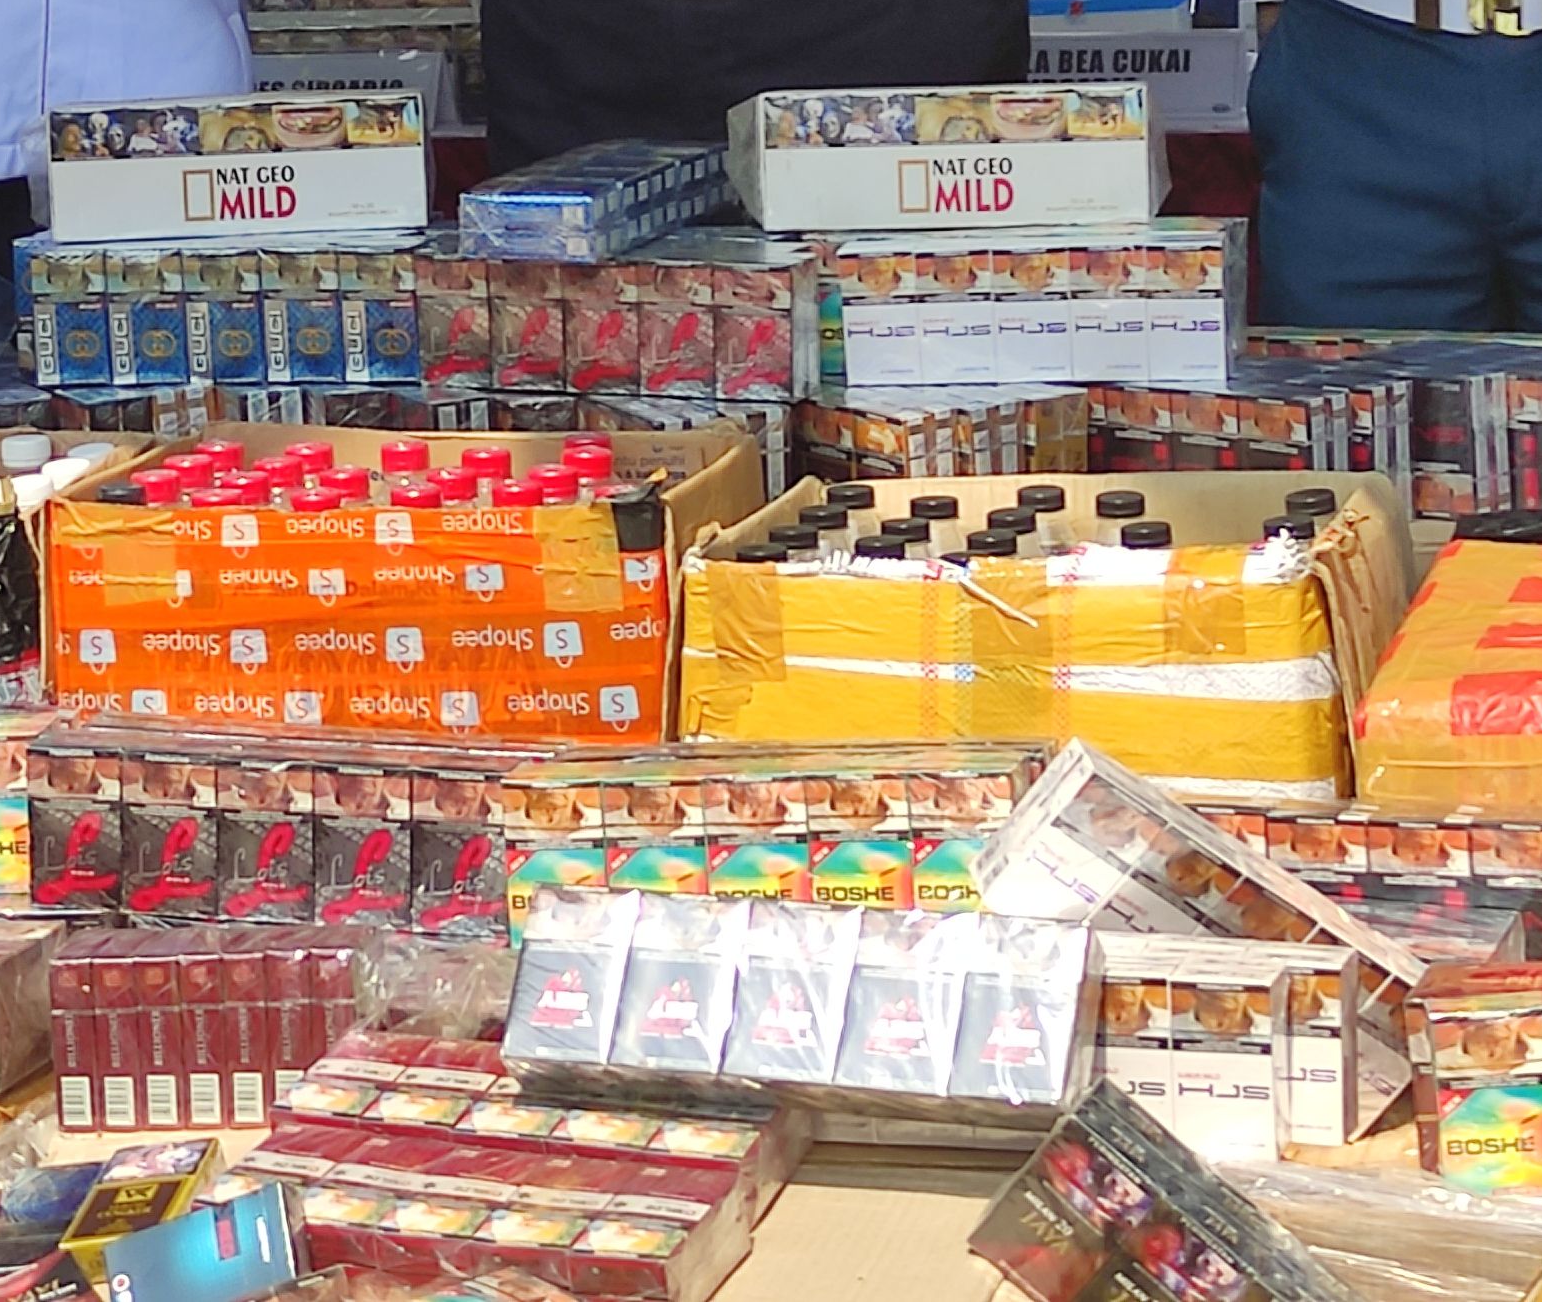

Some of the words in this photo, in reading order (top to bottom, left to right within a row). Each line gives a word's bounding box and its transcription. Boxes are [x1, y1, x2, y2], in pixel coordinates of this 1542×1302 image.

[1058, 49, 1105, 73] BEA
[1112, 49, 1191, 73] CUKAI
[215, 167, 252, 187] NAT
[257, 164, 295, 184] GEO
[932, 157, 968, 177] NAT
[973, 156, 1013, 176] GEO
[219, 185, 297, 221] MILD
[934, 177, 1015, 213] MILD
[440, 505, 524, 535] Shopee
[142, 631, 221, 656] Shopee
[294, 630, 376, 655] Shopee
[451, 627, 534, 652] Shopee
[194, 691, 275, 715] Shopee
[349, 696, 430, 718] Shopee
[506, 690, 590, 715] Shopee
[816, 885, 895, 904] BOSHE
[1177, 1081, 1271, 1101] HJS
[1445, 1134, 1536, 1157] BOSHE
